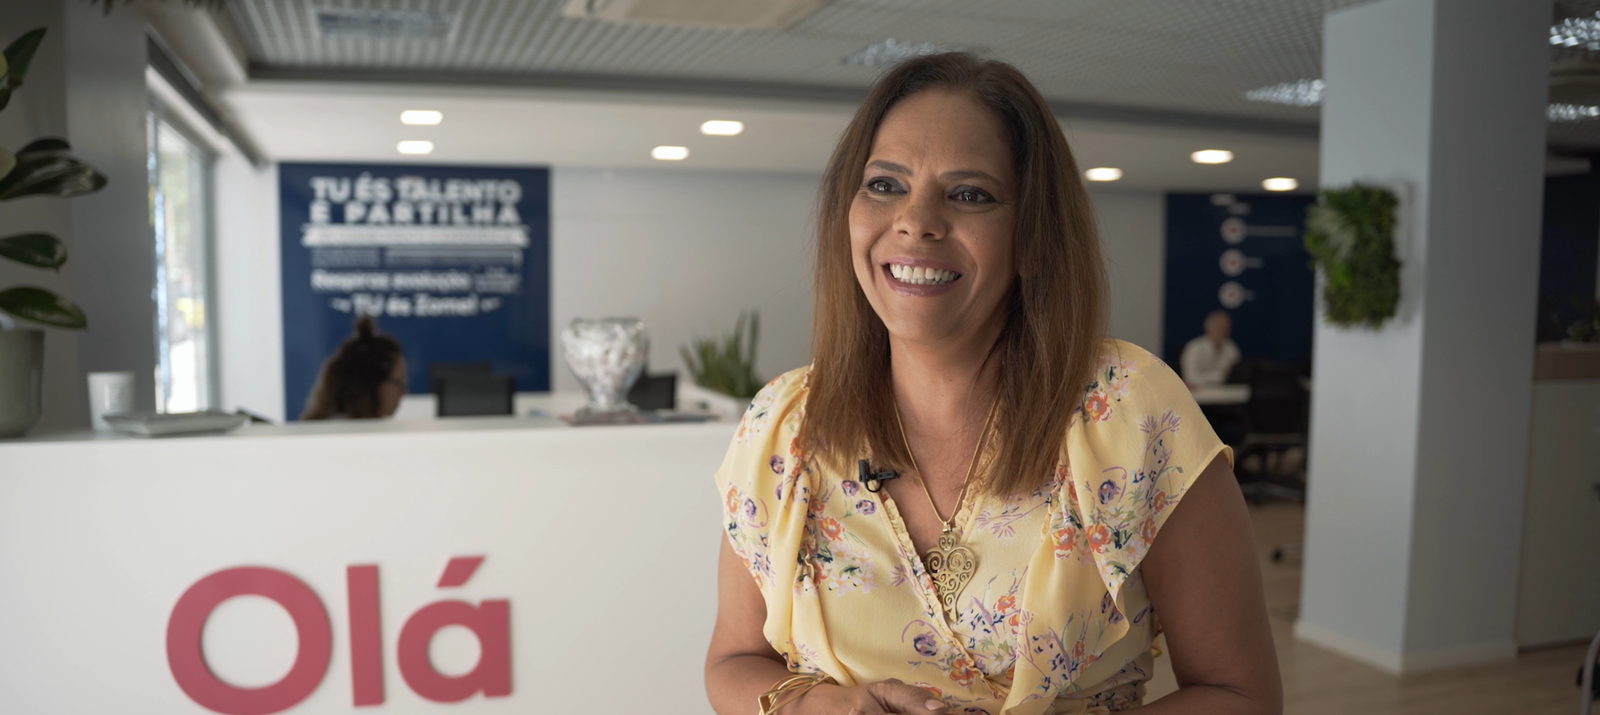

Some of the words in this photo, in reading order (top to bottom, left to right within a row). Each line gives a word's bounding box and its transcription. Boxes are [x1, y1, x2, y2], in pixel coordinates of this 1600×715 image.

[310, 176, 351, 203] TU
[354, 172, 392, 203] ÉS
[395, 176, 522, 205] TALENTO
[343, 202, 520, 224] PARTILHA
[166, 555, 513, 715] Olá
